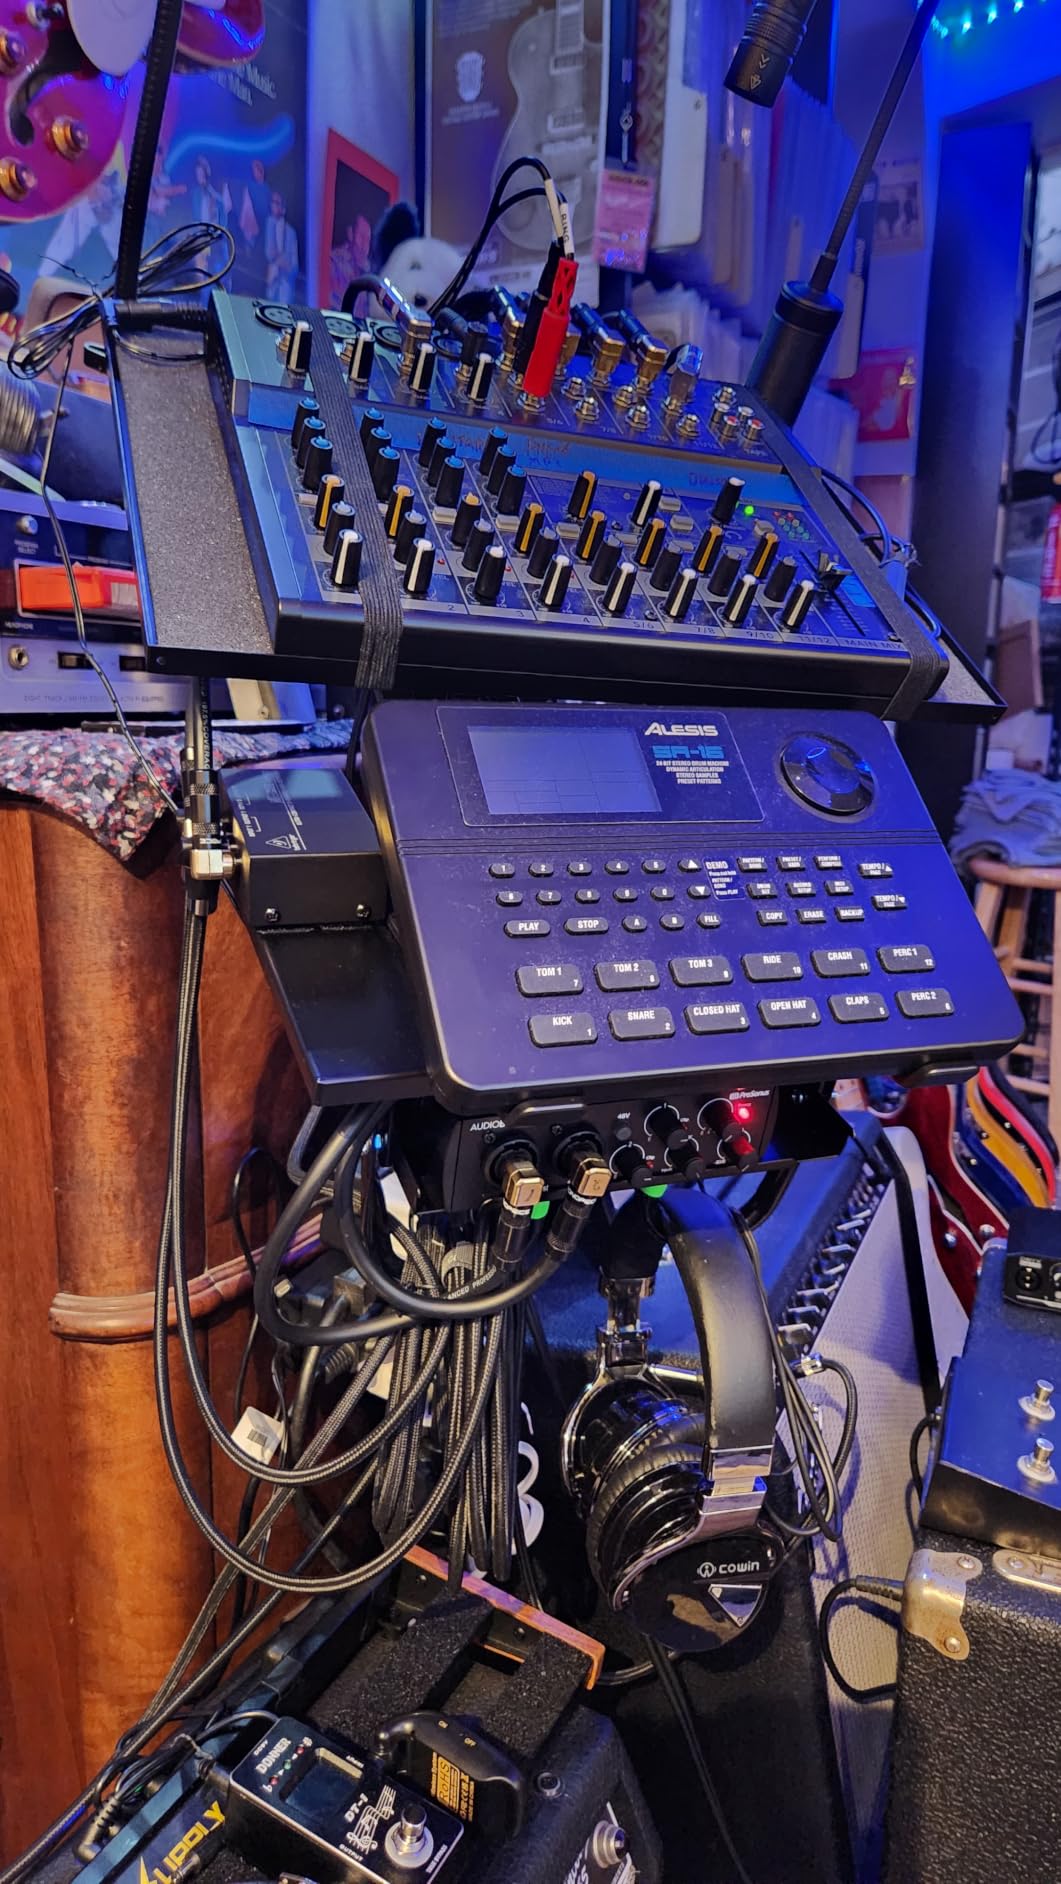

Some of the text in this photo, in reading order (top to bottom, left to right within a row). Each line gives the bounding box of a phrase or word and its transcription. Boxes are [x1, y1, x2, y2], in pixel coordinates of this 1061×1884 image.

[644, 721, 718, 737] ALESIS
[652, 745, 724, 759] SR-16
[766, 912, 783, 921] COPY
[804, 910, 824, 918] ERASE
[840, 909, 864, 917] BACKUP
[518, 922, 539, 931] PLAY
[578, 920, 599, 929] STOP
[827, 952, 853, 961] CRASH
[893, 948, 912, 957] PERC
[763, 955, 782, 964] RIDE
[614, 964, 632, 973] TOM
[688, 960, 706, 969] TOM
[536, 968, 555, 977] TOM
[846, 996, 870, 1005] CLAPS
[911, 992, 929, 1001] PERC
[693, 1004, 740, 1016] CLOSED HAT
[771, 1000, 807, 1011] OPEN HAT
[628, 1010, 655, 1021] SNARE
[552, 1016, 573, 1026] KICK
[617, 1112, 631, 1120] 48V
[256, 1737, 292, 1774] DONNER
[439, 1761, 450, 1802] RoHS
[344, 1793, 369, 1823] DT-1
[339, 1843, 364, 1862] OUTPUT
